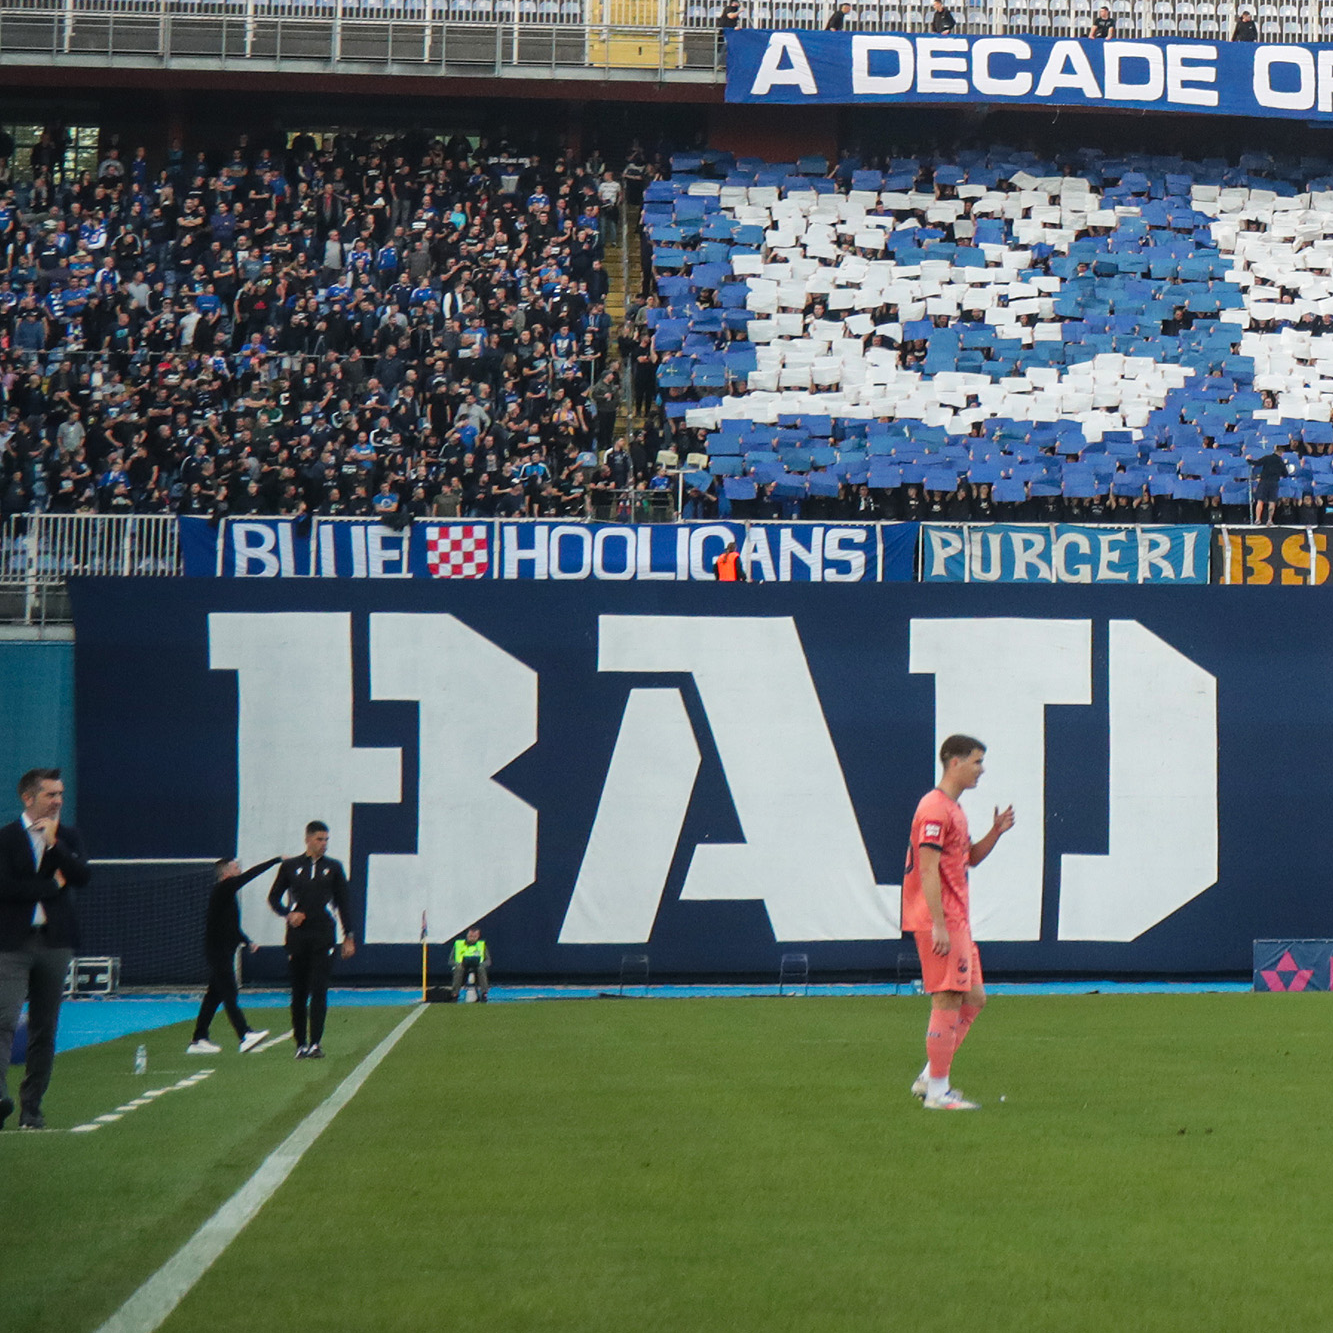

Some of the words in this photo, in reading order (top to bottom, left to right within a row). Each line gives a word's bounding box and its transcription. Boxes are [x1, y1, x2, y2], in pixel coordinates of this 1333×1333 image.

[750, 32, 817, 95] A
[851, 34, 1219, 107] DECADE
[232, 522, 412, 578] BLUE
[503, 524, 866, 583] HOOLIGANS
[929, 529, 1198, 582] PURGERI
[208, 611, 1217, 944] BAD
